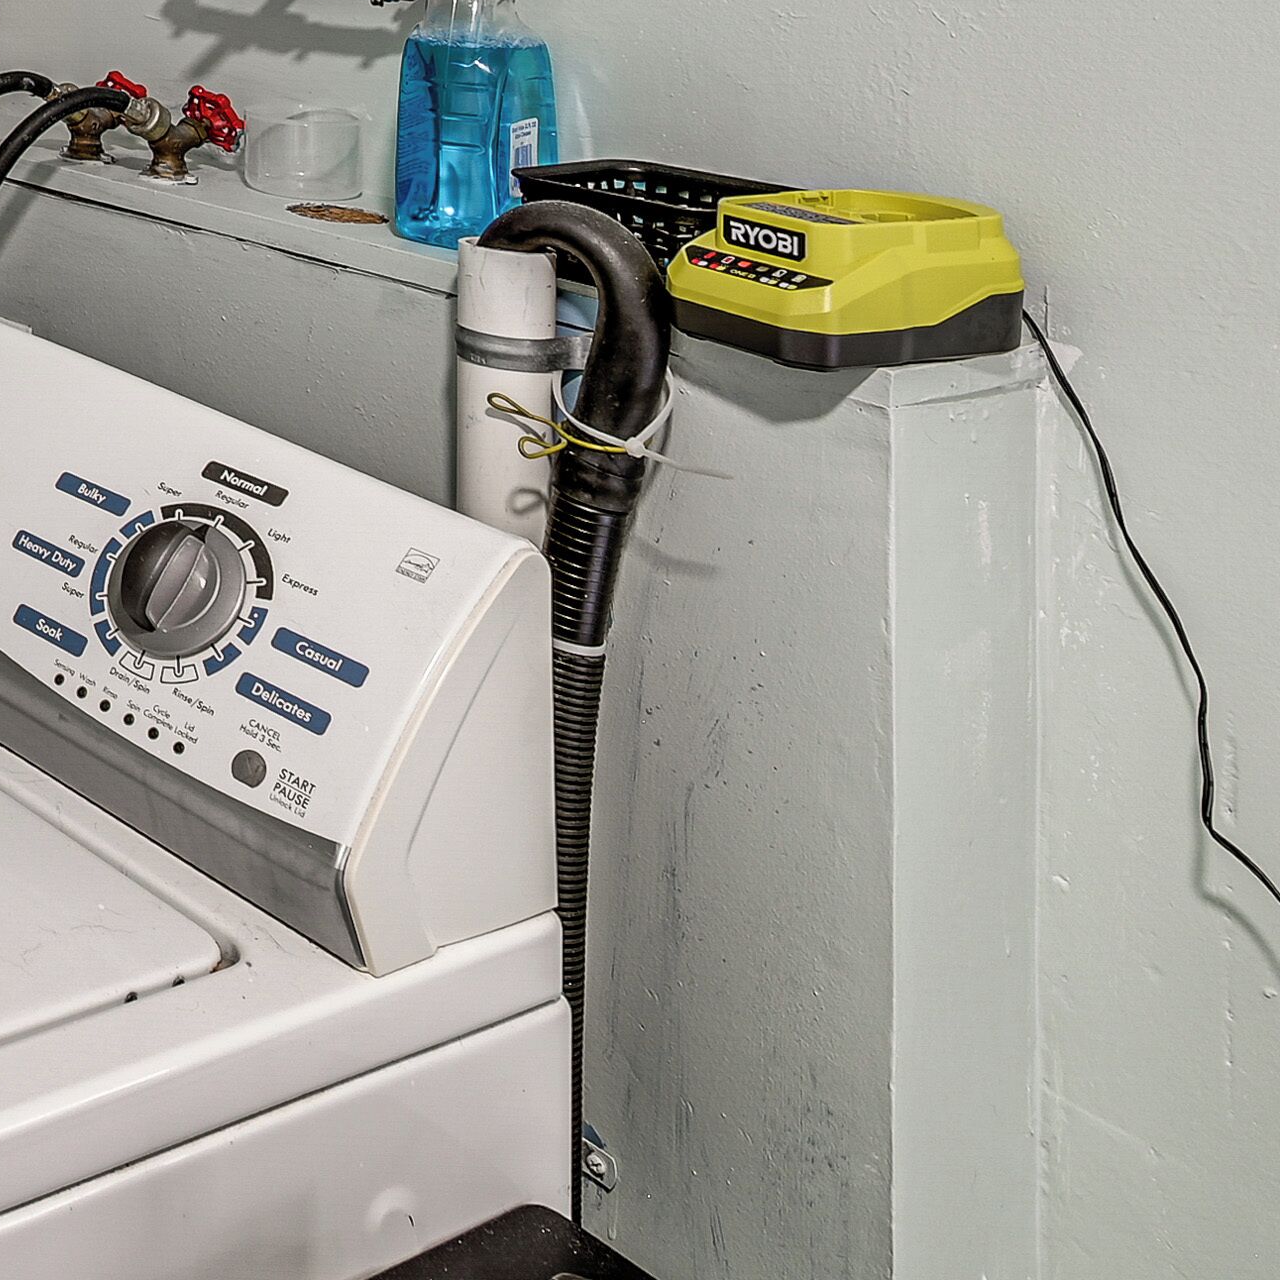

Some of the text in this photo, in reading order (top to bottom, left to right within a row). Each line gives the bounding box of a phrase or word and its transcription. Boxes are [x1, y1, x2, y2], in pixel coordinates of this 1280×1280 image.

[728, 220, 800, 257] RYOBI
[77, 482, 107, 505] Bulky
[157, 481, 183, 497] Super
[219, 469, 269, 497] Normal
[214, 489, 250, 509] Regular
[67, 534, 100, 555] Regular
[266, 527, 291, 544] Light
[17, 534, 77, 573] Heavy Duty
[60, 581, 86, 599] Super
[281, 573, 319, 597] Express
[34, 618, 64, 643] Soak
[53, 658, 76, 677] Sensing
[294, 640, 344, 672] Casual
[79, 672, 97, 687] Wash
[108, 665, 151, 696] Drain/Spin
[125, 698, 141, 712] Spin
[152, 703, 172, 719] Cycle
[171, 686, 216, 717] Rinse/Spin
[250, 681, 314, 723] Delicates
[142, 708, 174, 732] Complete
[183, 721, 196, 733] Lid
[248, 718, 282, 743] CANCEL
[173, 726, 199, 745] Locked
[239, 723, 283, 754] Hold 3 Sec.
[277, 768, 317, 796] START
[268, 792, 307, 819] Unlock Lid
[272, 781, 311, 811] PAUSE
